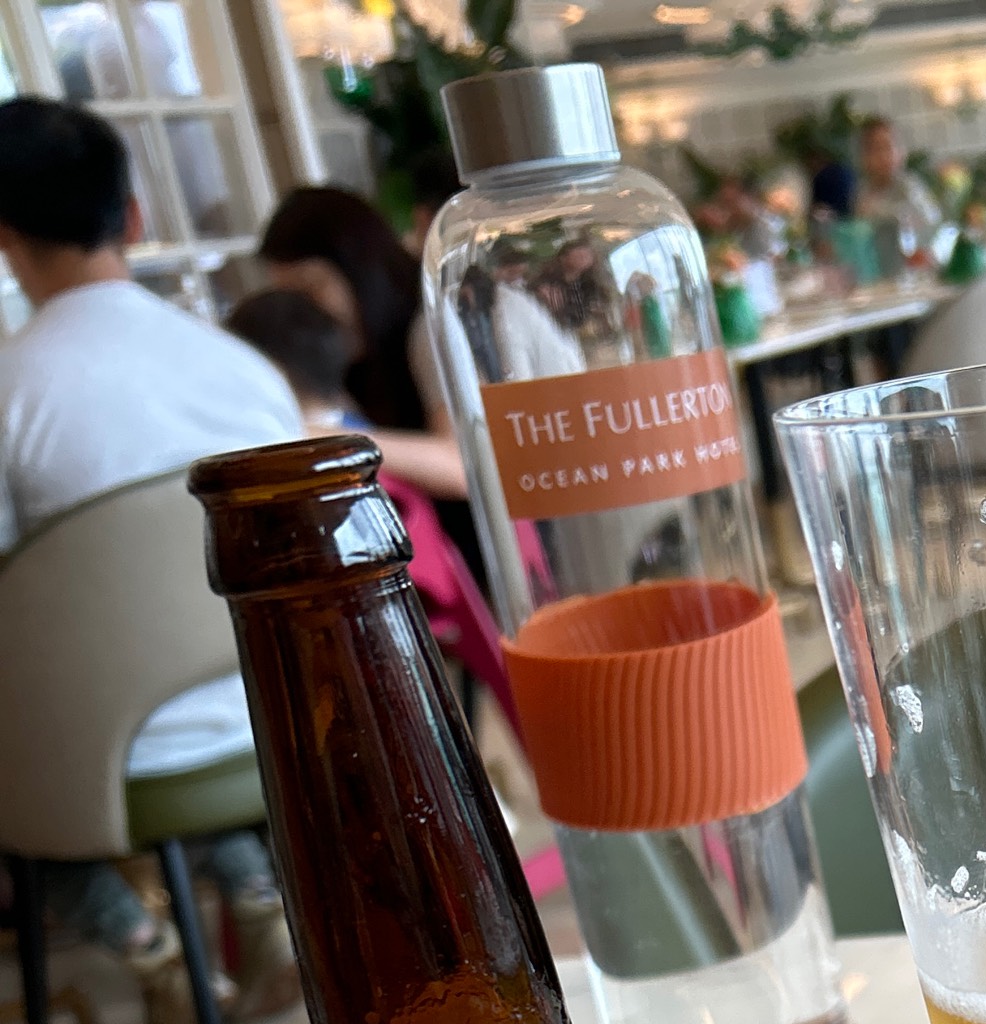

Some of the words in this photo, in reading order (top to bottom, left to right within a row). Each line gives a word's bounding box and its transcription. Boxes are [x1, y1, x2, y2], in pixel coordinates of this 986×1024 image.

[505, 409, 575, 447] THE
[518, 463, 609, 492] OCEAN
[622, 449, 687, 478] PARK
